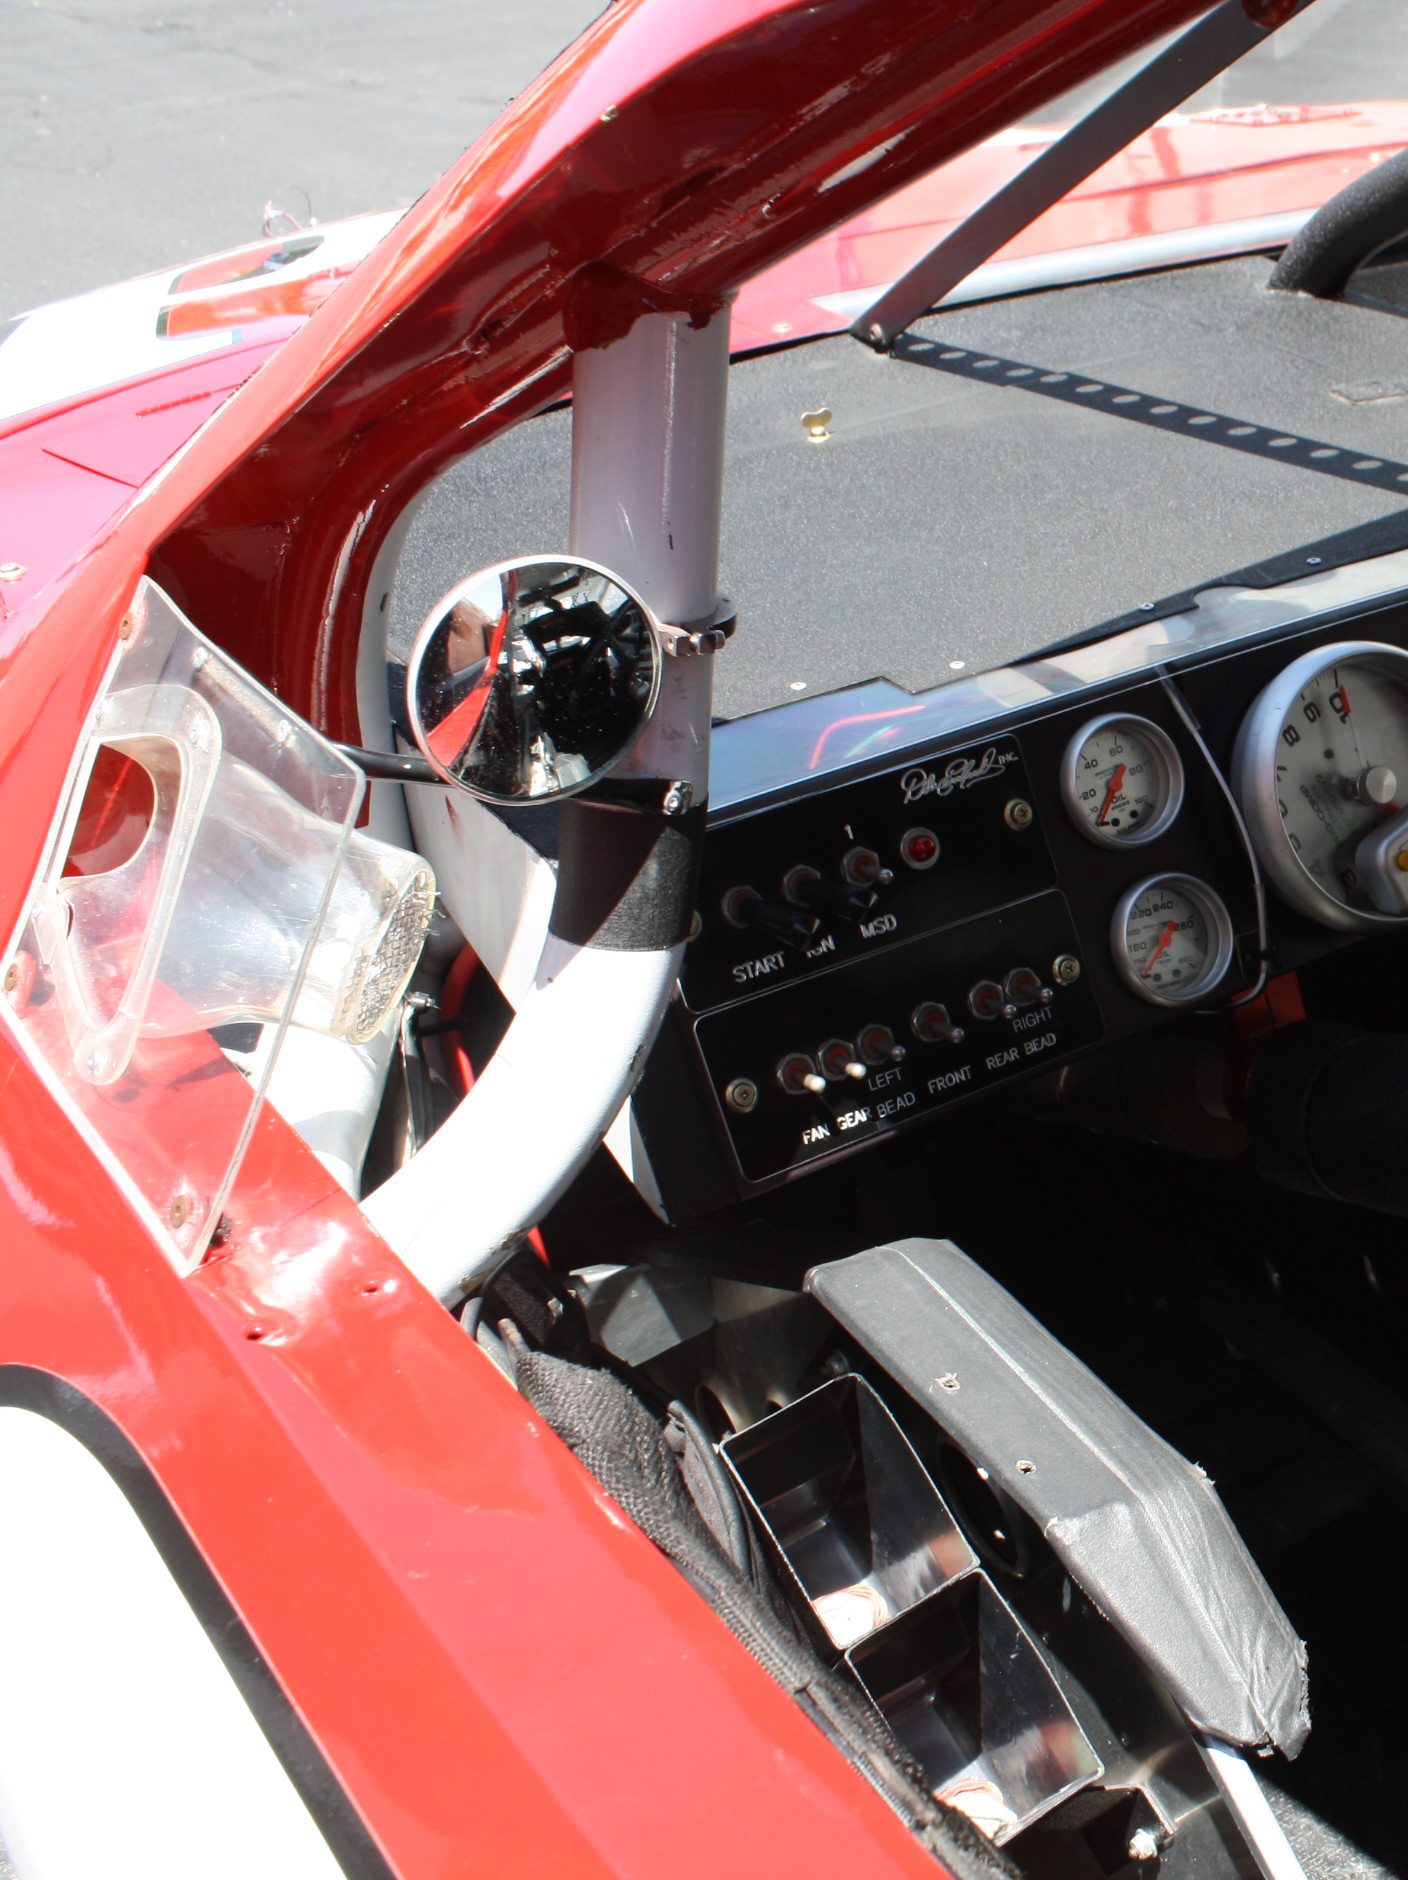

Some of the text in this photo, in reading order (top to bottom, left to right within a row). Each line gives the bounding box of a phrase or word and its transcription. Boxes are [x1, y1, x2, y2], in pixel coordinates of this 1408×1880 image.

[1282, 724, 1300, 747] 8
[1109, 745, 1123, 757] 60
[1084, 759, 1098, 770] 40
[1128, 764, 1143, 776] 80
[1082, 788, 1096, 800] 20
[1111, 793, 1126, 804] OIL
[1152, 900, 1174, 913] 240
[732, 951, 785, 983] START
[859, 913, 898, 939] MSD
[1012, 1006, 1053, 1033] RIGHT
[867, 1066, 903, 1091] LEFT
[802, 1032, 1057, 1145] FAN GEAR BEAD FRONT REAR BEAD
